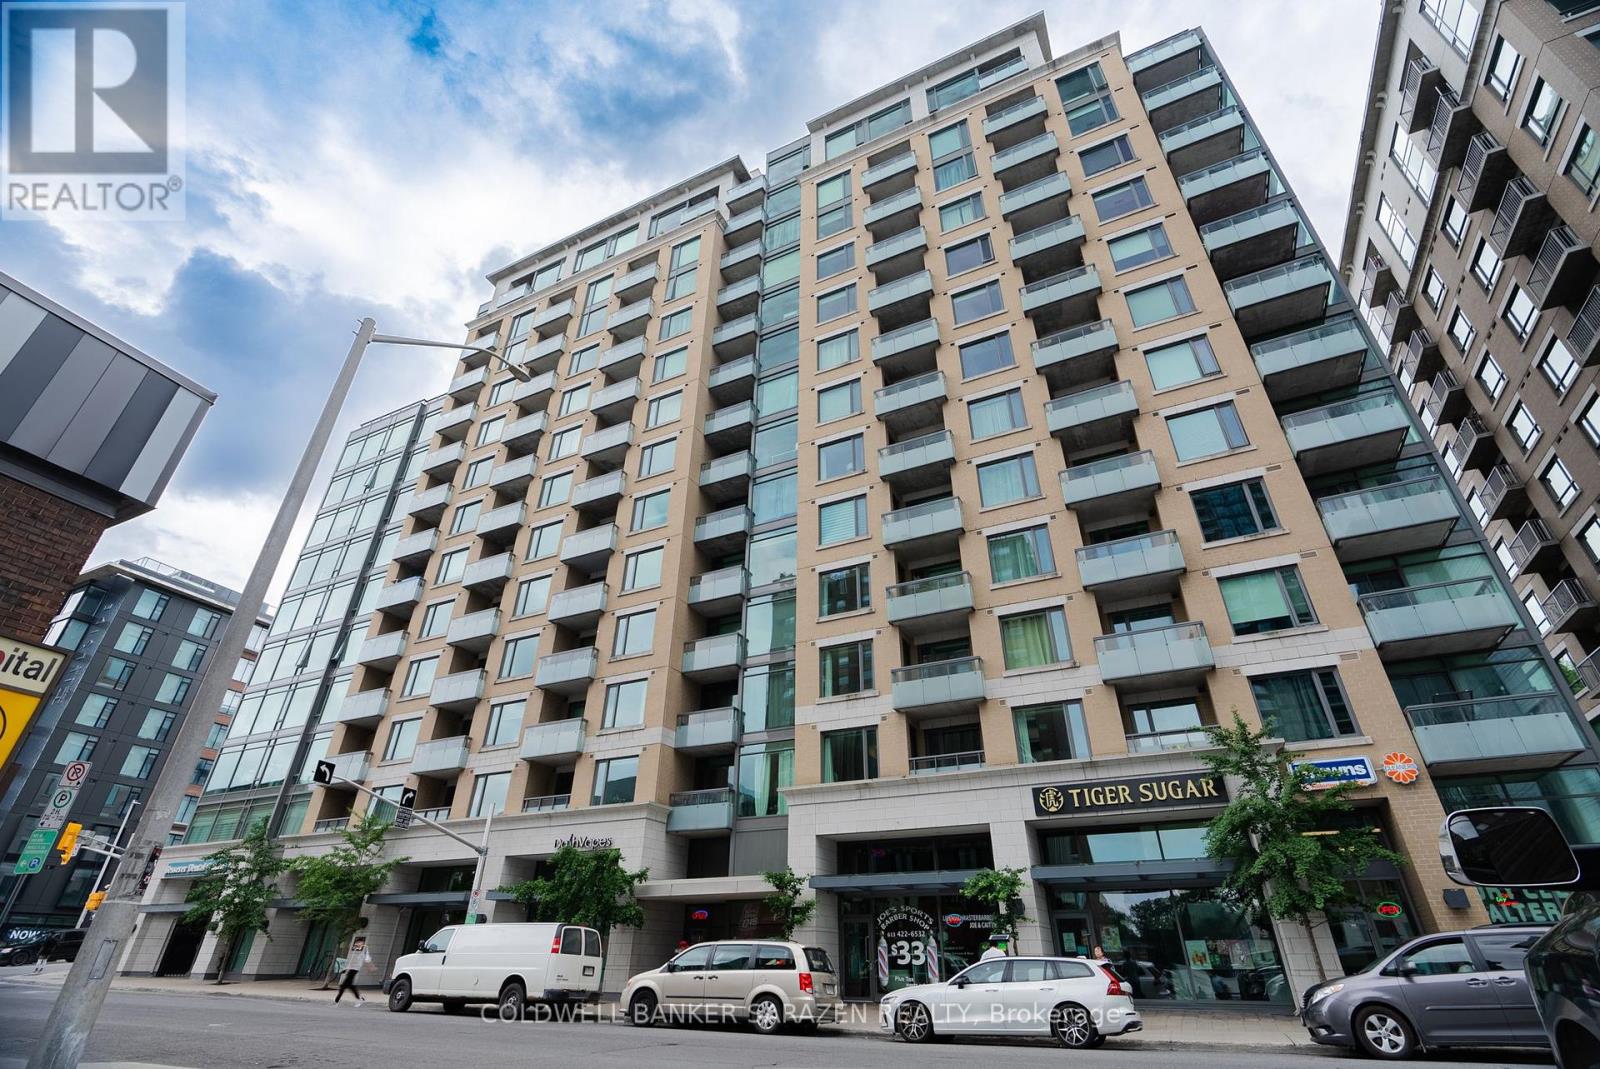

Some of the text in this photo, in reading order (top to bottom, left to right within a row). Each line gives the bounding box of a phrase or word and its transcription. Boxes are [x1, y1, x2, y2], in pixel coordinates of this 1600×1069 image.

[1068, 778, 1219, 808] TIGER SUGAR
[900, 905, 934, 925] SPORTS
[1378, 905, 1399, 914] OPEN
[880, 913, 907, 930] BARBER
[909, 915, 930, 930] SHOP
[891, 940, 926, 966] $33
